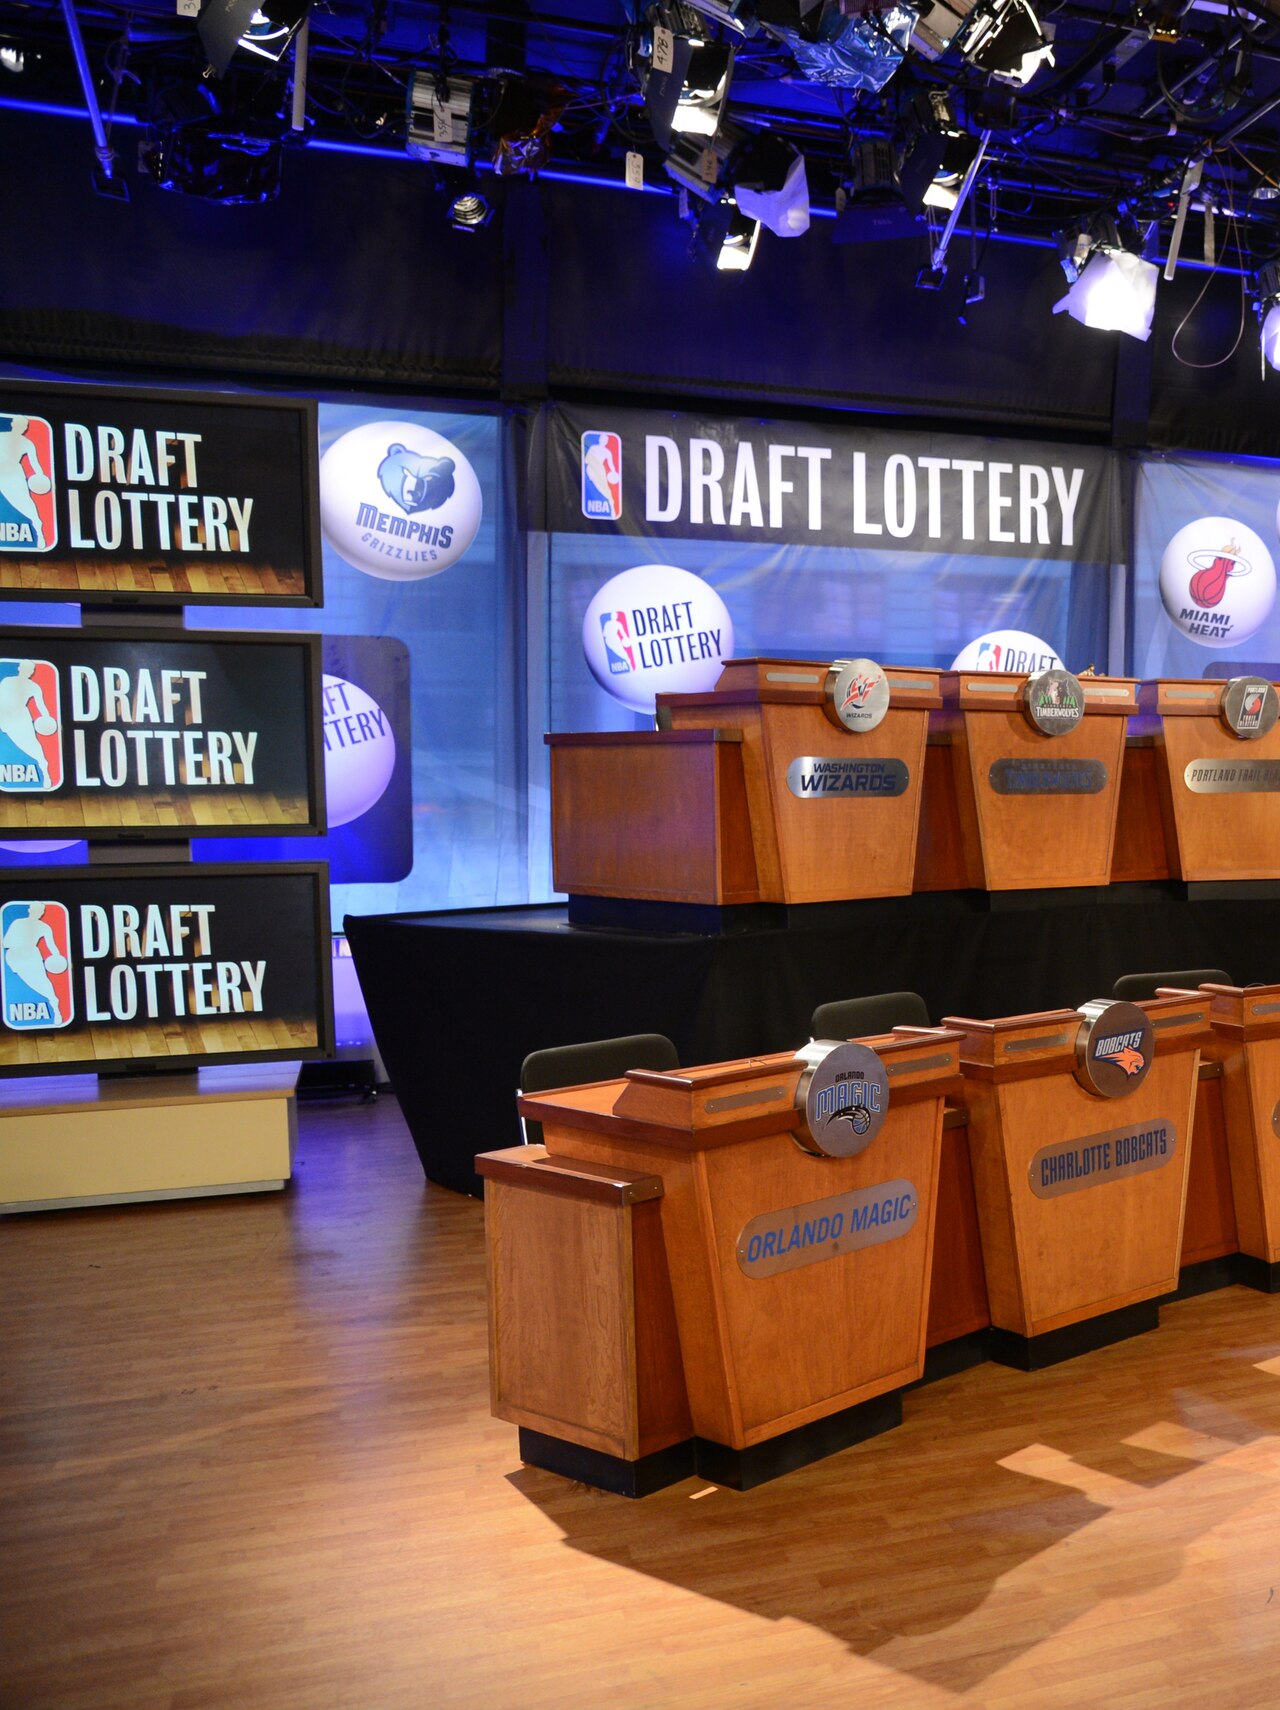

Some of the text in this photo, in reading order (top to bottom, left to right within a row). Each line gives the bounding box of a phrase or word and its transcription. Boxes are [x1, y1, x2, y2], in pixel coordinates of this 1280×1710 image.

[656, 36, 669, 65] 478
[65, 423, 202, 488] DRAFT
[587, 499, 612, 515] NBA
[645, 435, 1084, 547] DRAFT LOTTERY
[68, 490, 253, 552] LOTTERY
[356, 502, 454, 549] MEMPHIS
[361, 532, 438, 562] GRIZZLIES
[632, 601, 693, 637] DRAFT
[1180, 608, 1230, 625] MIAMI
[1189, 623, 1234, 638] HEAT
[639, 629, 721, 669] LOTTERY
[71, 666, 206, 724] DRAFT
[0, 764, 39, 783] NBA
[74, 729, 258, 787] LOTTERY
[813, 763, 886, 773] WASHINGTON
[1191, 769, 1237, 782] PORTLAND
[1238, 769, 1261, 782] TRAIL
[801, 774, 896, 792] WIZARDS
[81, 904, 215, 959] DRAFT
[84, 960, 266, 1021] LOTTERY
[10, 1003, 49, 1021] NBA
[1095, 1031, 1143, 1057] BOBCATS
[835, 1071, 864, 1083] ORLANDO
[816, 1081, 881, 1122] MAGIC
[1041, 1128, 1167, 1187] CHARLOTTE BOBCATS
[748, 1194, 911, 1262] ORLANDO MAGIC
